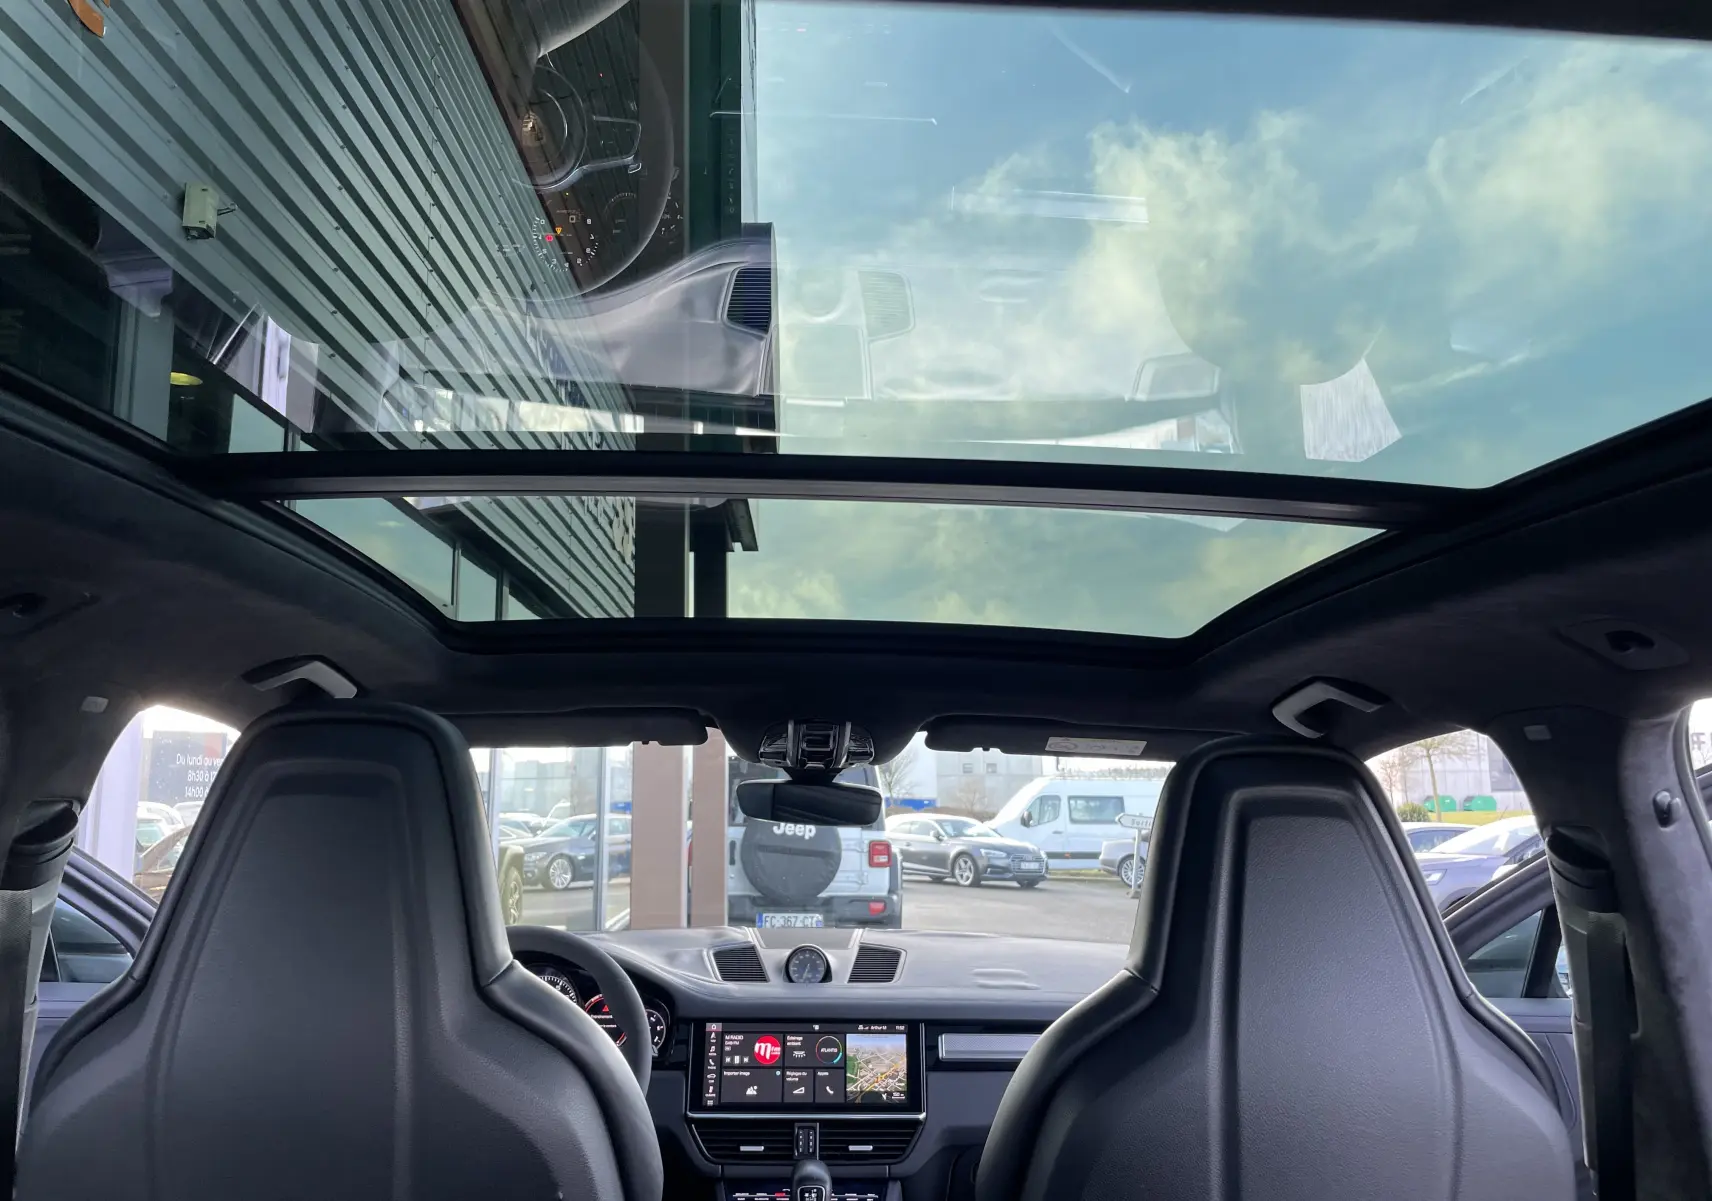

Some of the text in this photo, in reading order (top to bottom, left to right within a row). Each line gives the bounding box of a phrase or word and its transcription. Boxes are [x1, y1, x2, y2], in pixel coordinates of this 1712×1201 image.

[176, 753, 186, 765] Du
[187, 754, 203, 766] lundi
[187, 770, 204, 782] 8h30
[184, 786, 204, 798] 14h00
[772, 823, 816, 840] Jeep
